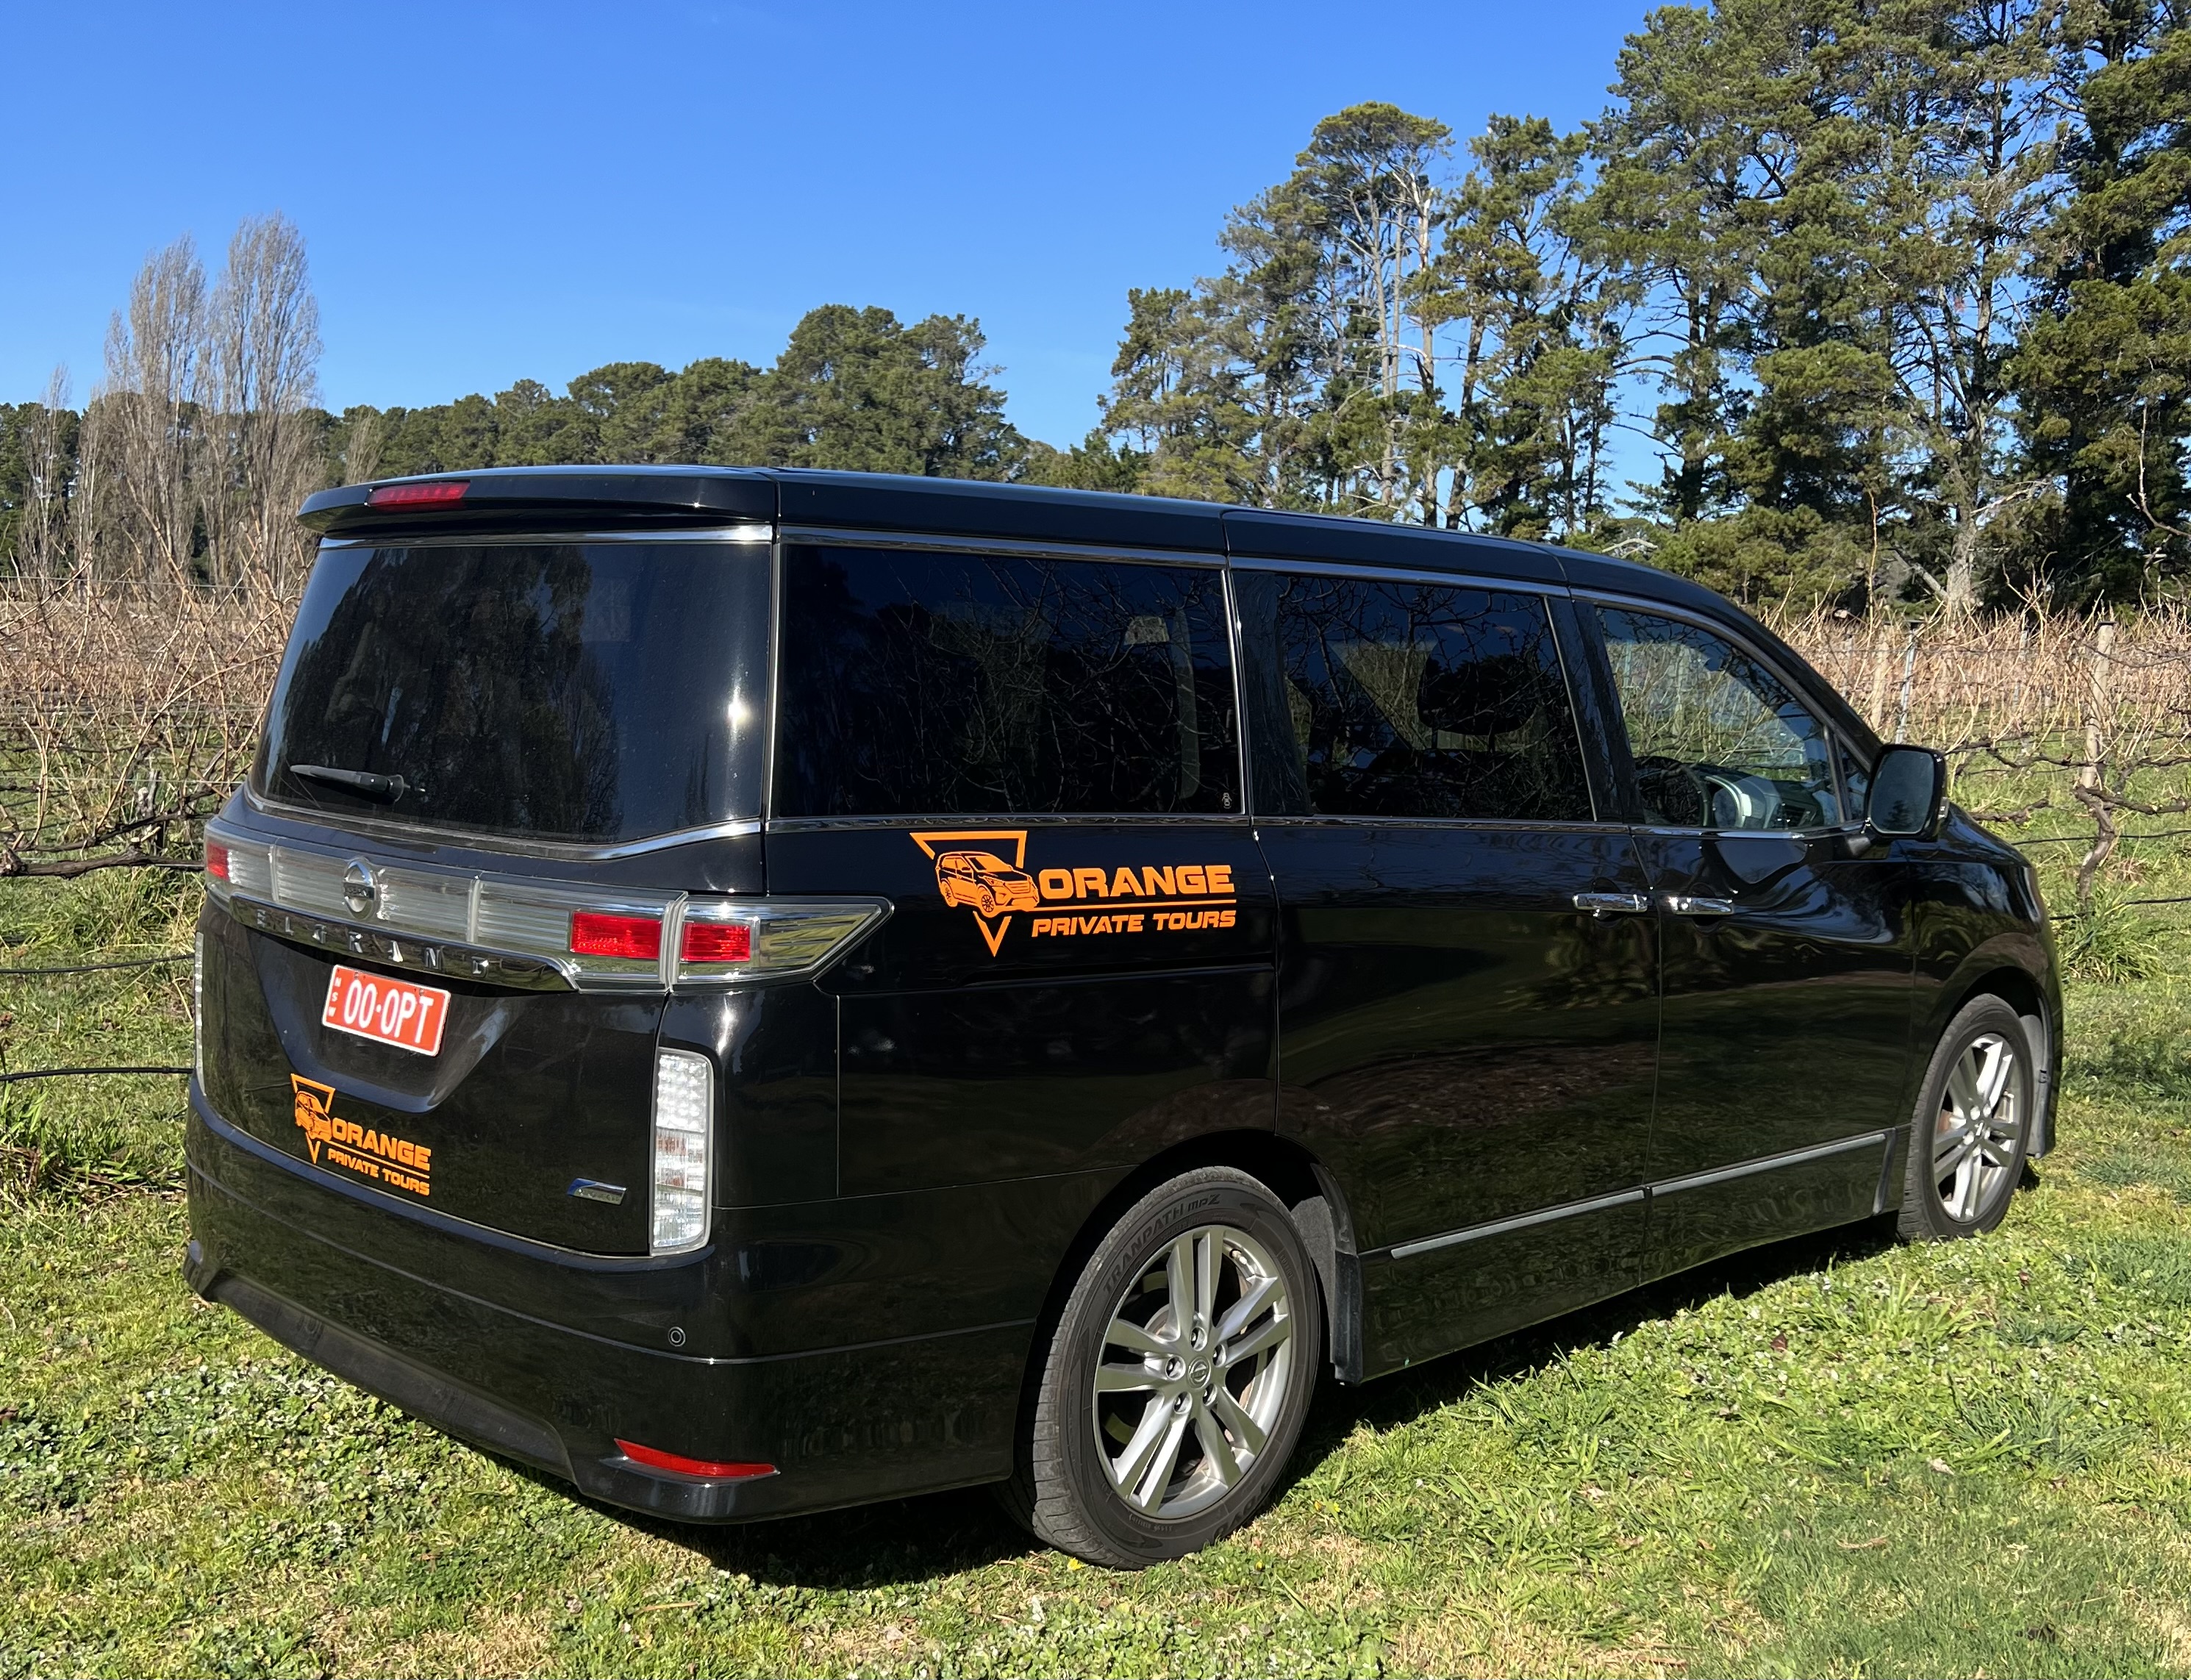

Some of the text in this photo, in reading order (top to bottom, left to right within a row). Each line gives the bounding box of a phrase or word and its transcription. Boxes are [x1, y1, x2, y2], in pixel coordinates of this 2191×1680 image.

[1038, 865, 1235, 900] ORANGE
[257, 909, 488, 978] ELGRAND
[1032, 910, 1237, 937] PRIVATE TOURS
[331, 1117, 432, 1171] ORANGE
[328, 1148, 430, 1196] PRIVATE TOURS
[1103, 1204, 1184, 1294] TRANPATH
